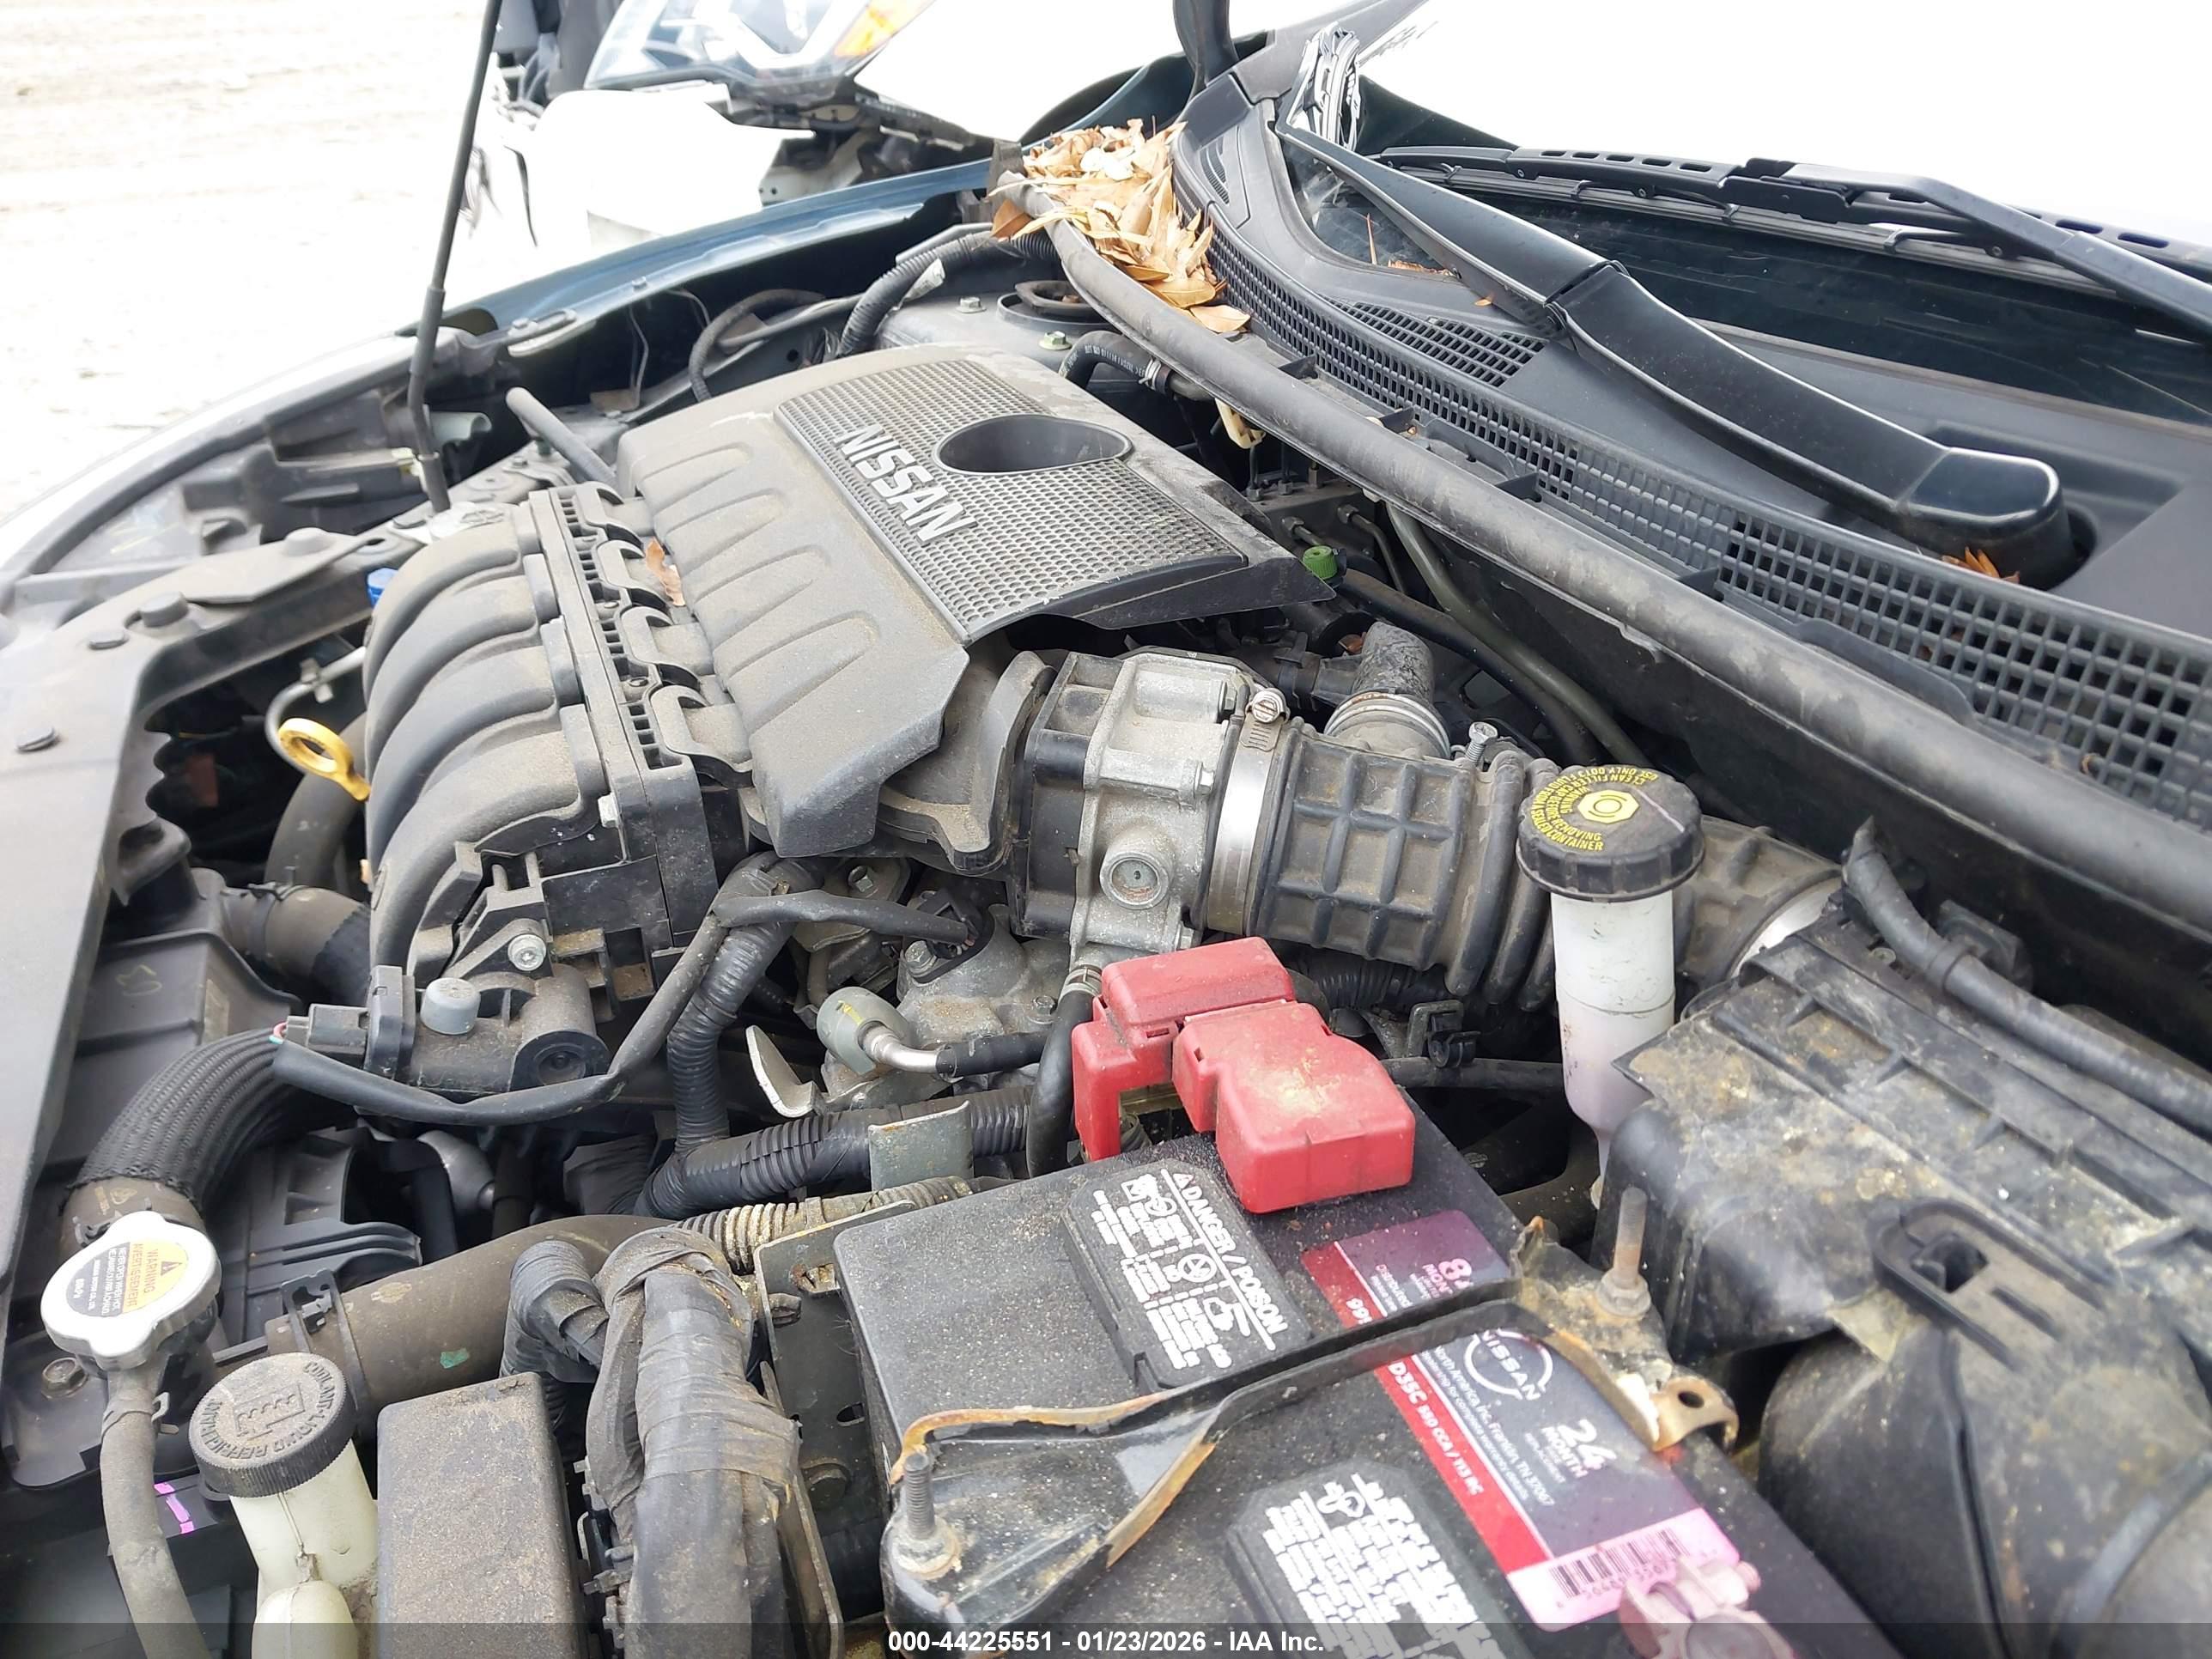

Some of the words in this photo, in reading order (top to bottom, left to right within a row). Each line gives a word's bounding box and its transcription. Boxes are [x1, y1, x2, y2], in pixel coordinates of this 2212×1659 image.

[833, 424, 978, 542] NISSAN
[1548, 772, 1577, 790] FLUID
[1572, 775, 1608, 787] FILLER
[1609, 767, 1637, 777] ONLY
[1610, 775, 1645, 787] CLEAN
[1641, 769, 1658, 781] USE
[1535, 787, 1553, 805] FROM
[1557, 780, 1574, 797] CAP
[1559, 787, 1590, 814] WARNING
[1547, 795, 1561, 819] BEFORE
[1531, 810, 1553, 836] SEALED
[1551, 816, 1602, 842] REMOVING
[1546, 828, 1604, 850] CONTAINER
[1182, 1186, 1237, 1254] DANGER
[116, 1265, 125, 1280] OPEN
[144, 1249, 158, 1293] WARNING
[1221, 1255, 1247, 1264] /
[128, 1243, 144, 1307] AVERTISSEMENT
[1376, 1264, 1413, 1309] Distributed
[1231, 1265, 1288, 1334] POISON
[1483, 1330, 1541, 1401] NISSAN
[1541, 1426, 1589, 1478] MONTH
[1556, 1419, 1617, 1471] 24
[1432, 1427, 1454, 1451] CCA
[1465, 1474, 1484, 1496] RC
[1489, 1422, 1519, 1464] Franklin,
[1516, 1461, 1531, 1479] TN
[1527, 1474, 1555, 1505] 37067
